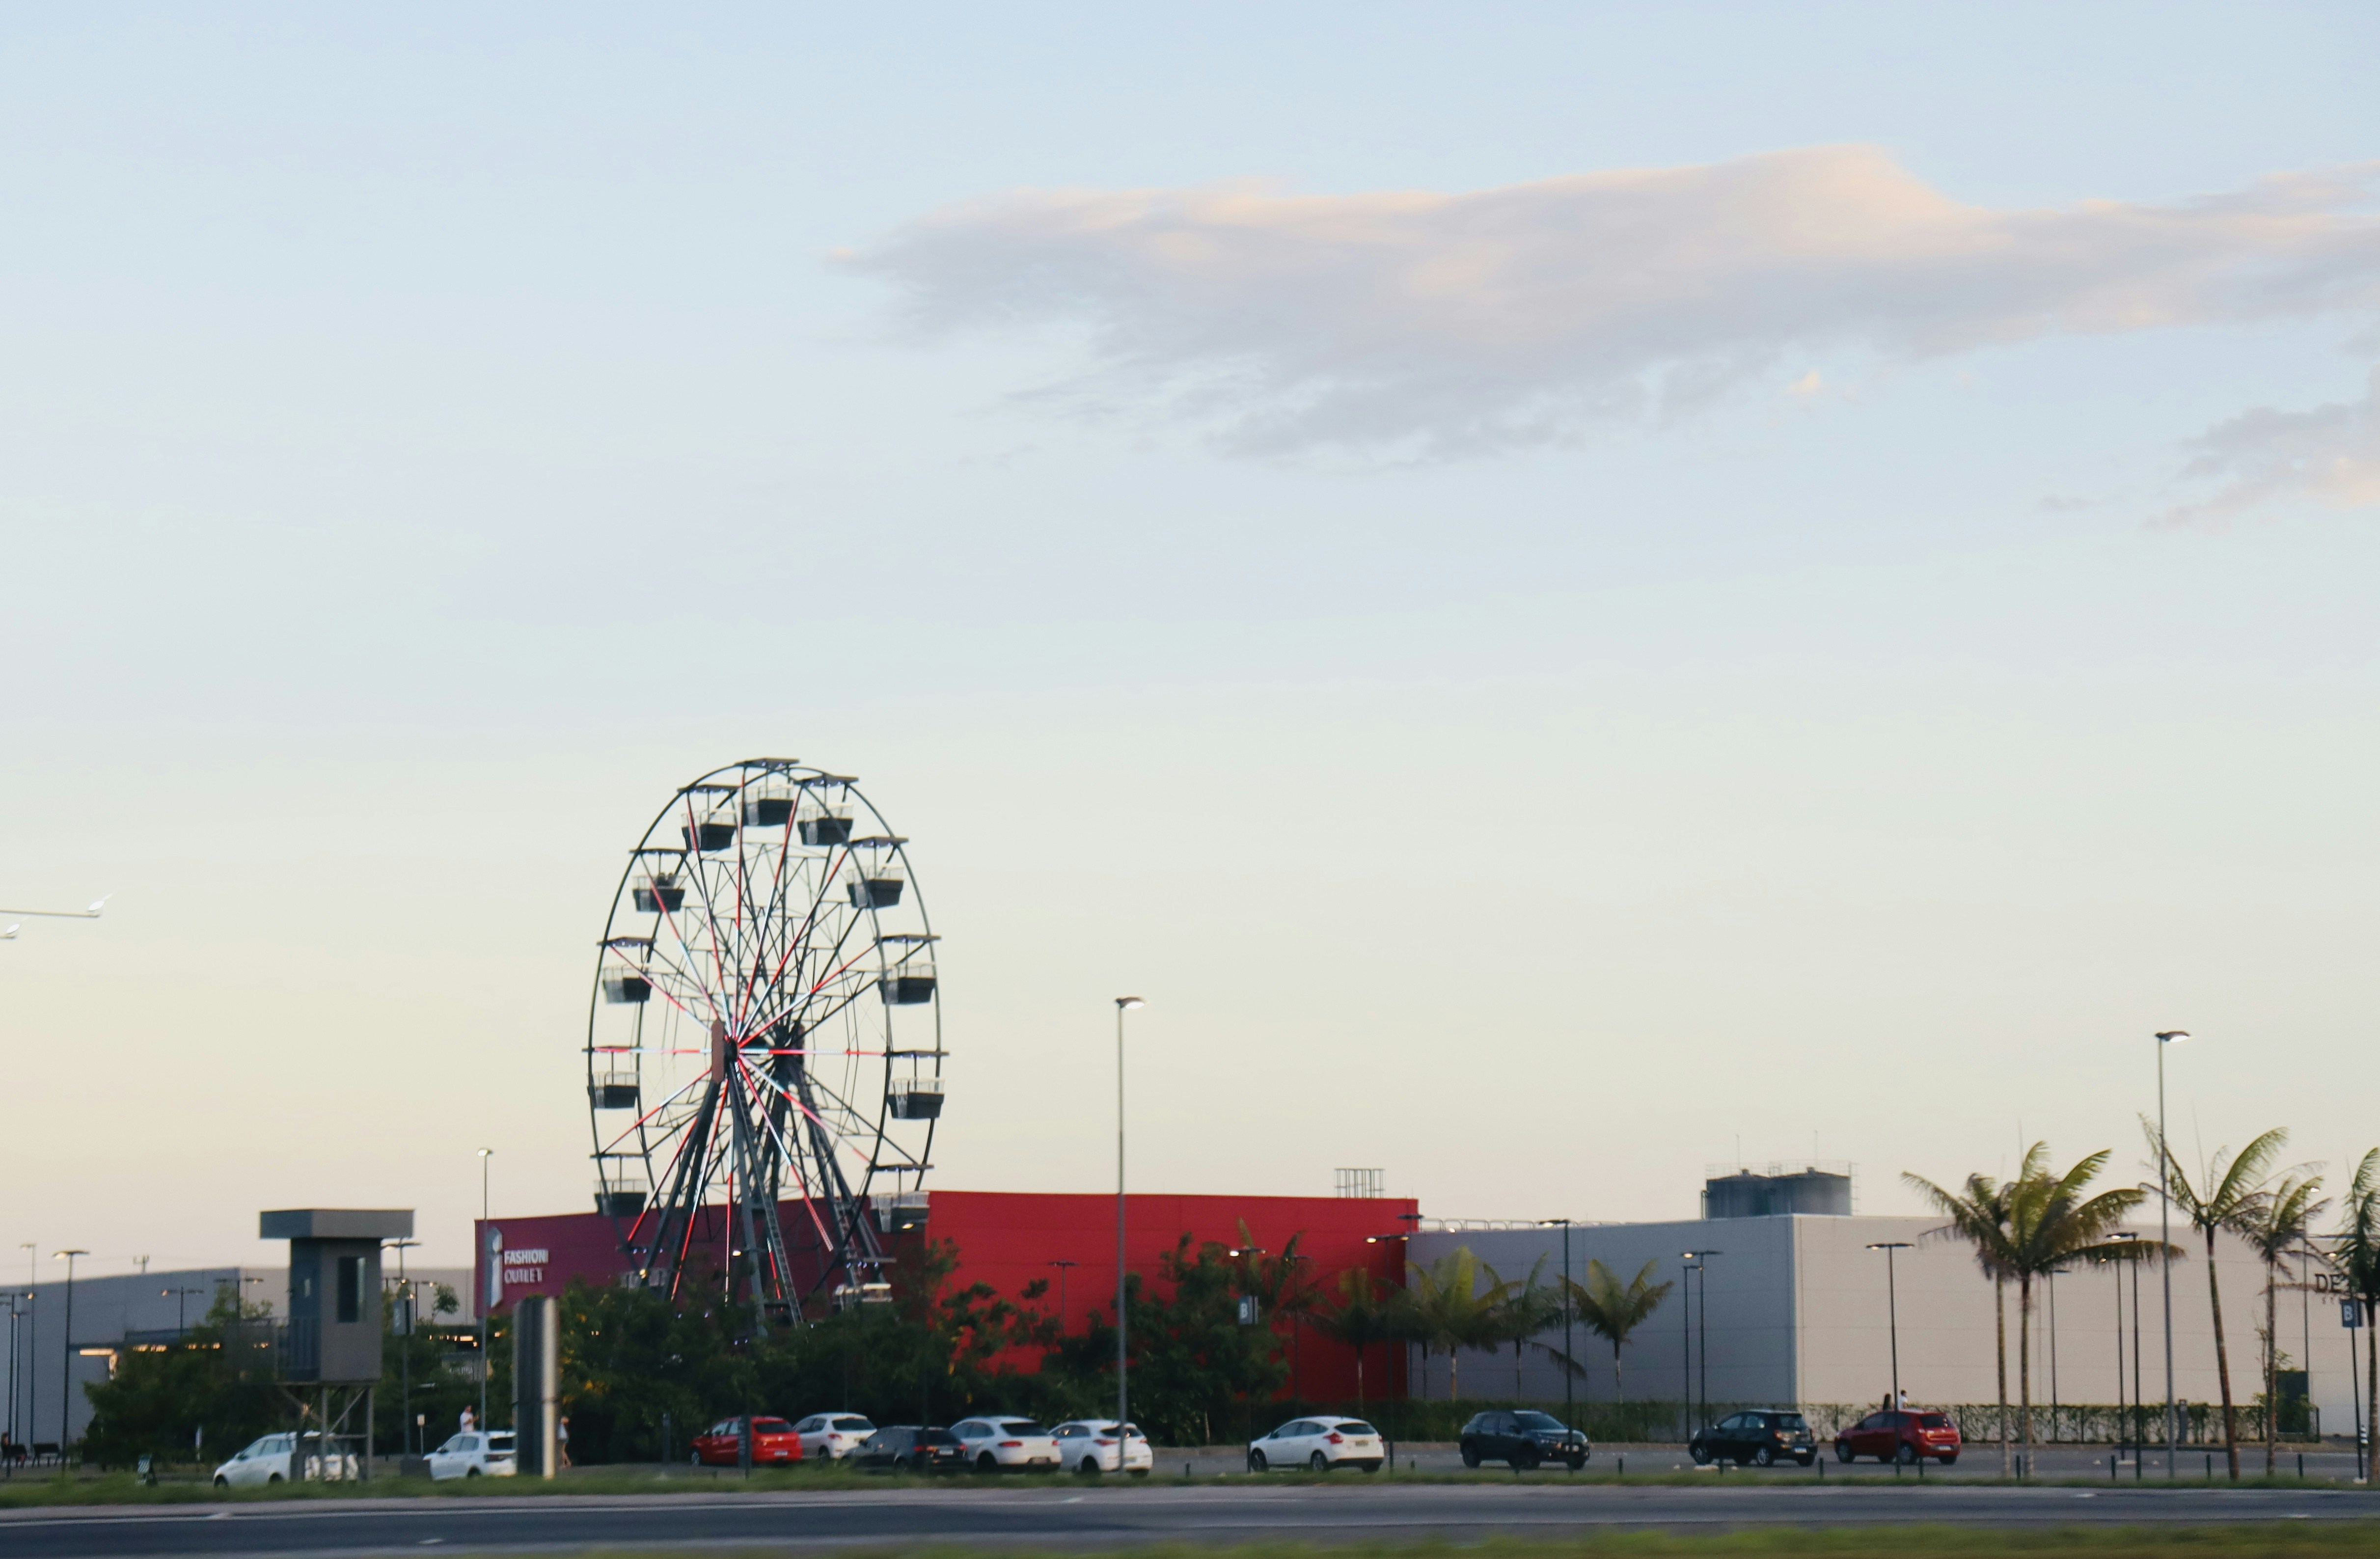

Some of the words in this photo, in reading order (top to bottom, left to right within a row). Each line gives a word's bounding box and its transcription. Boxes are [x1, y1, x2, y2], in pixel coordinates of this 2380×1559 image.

[504, 1249, 548, 1265] FASHION
[505, 1268, 543, 1284] OUTLET
[2314, 1273, 2345, 1292] DE
[2344, 1305, 2353, 1321] B
